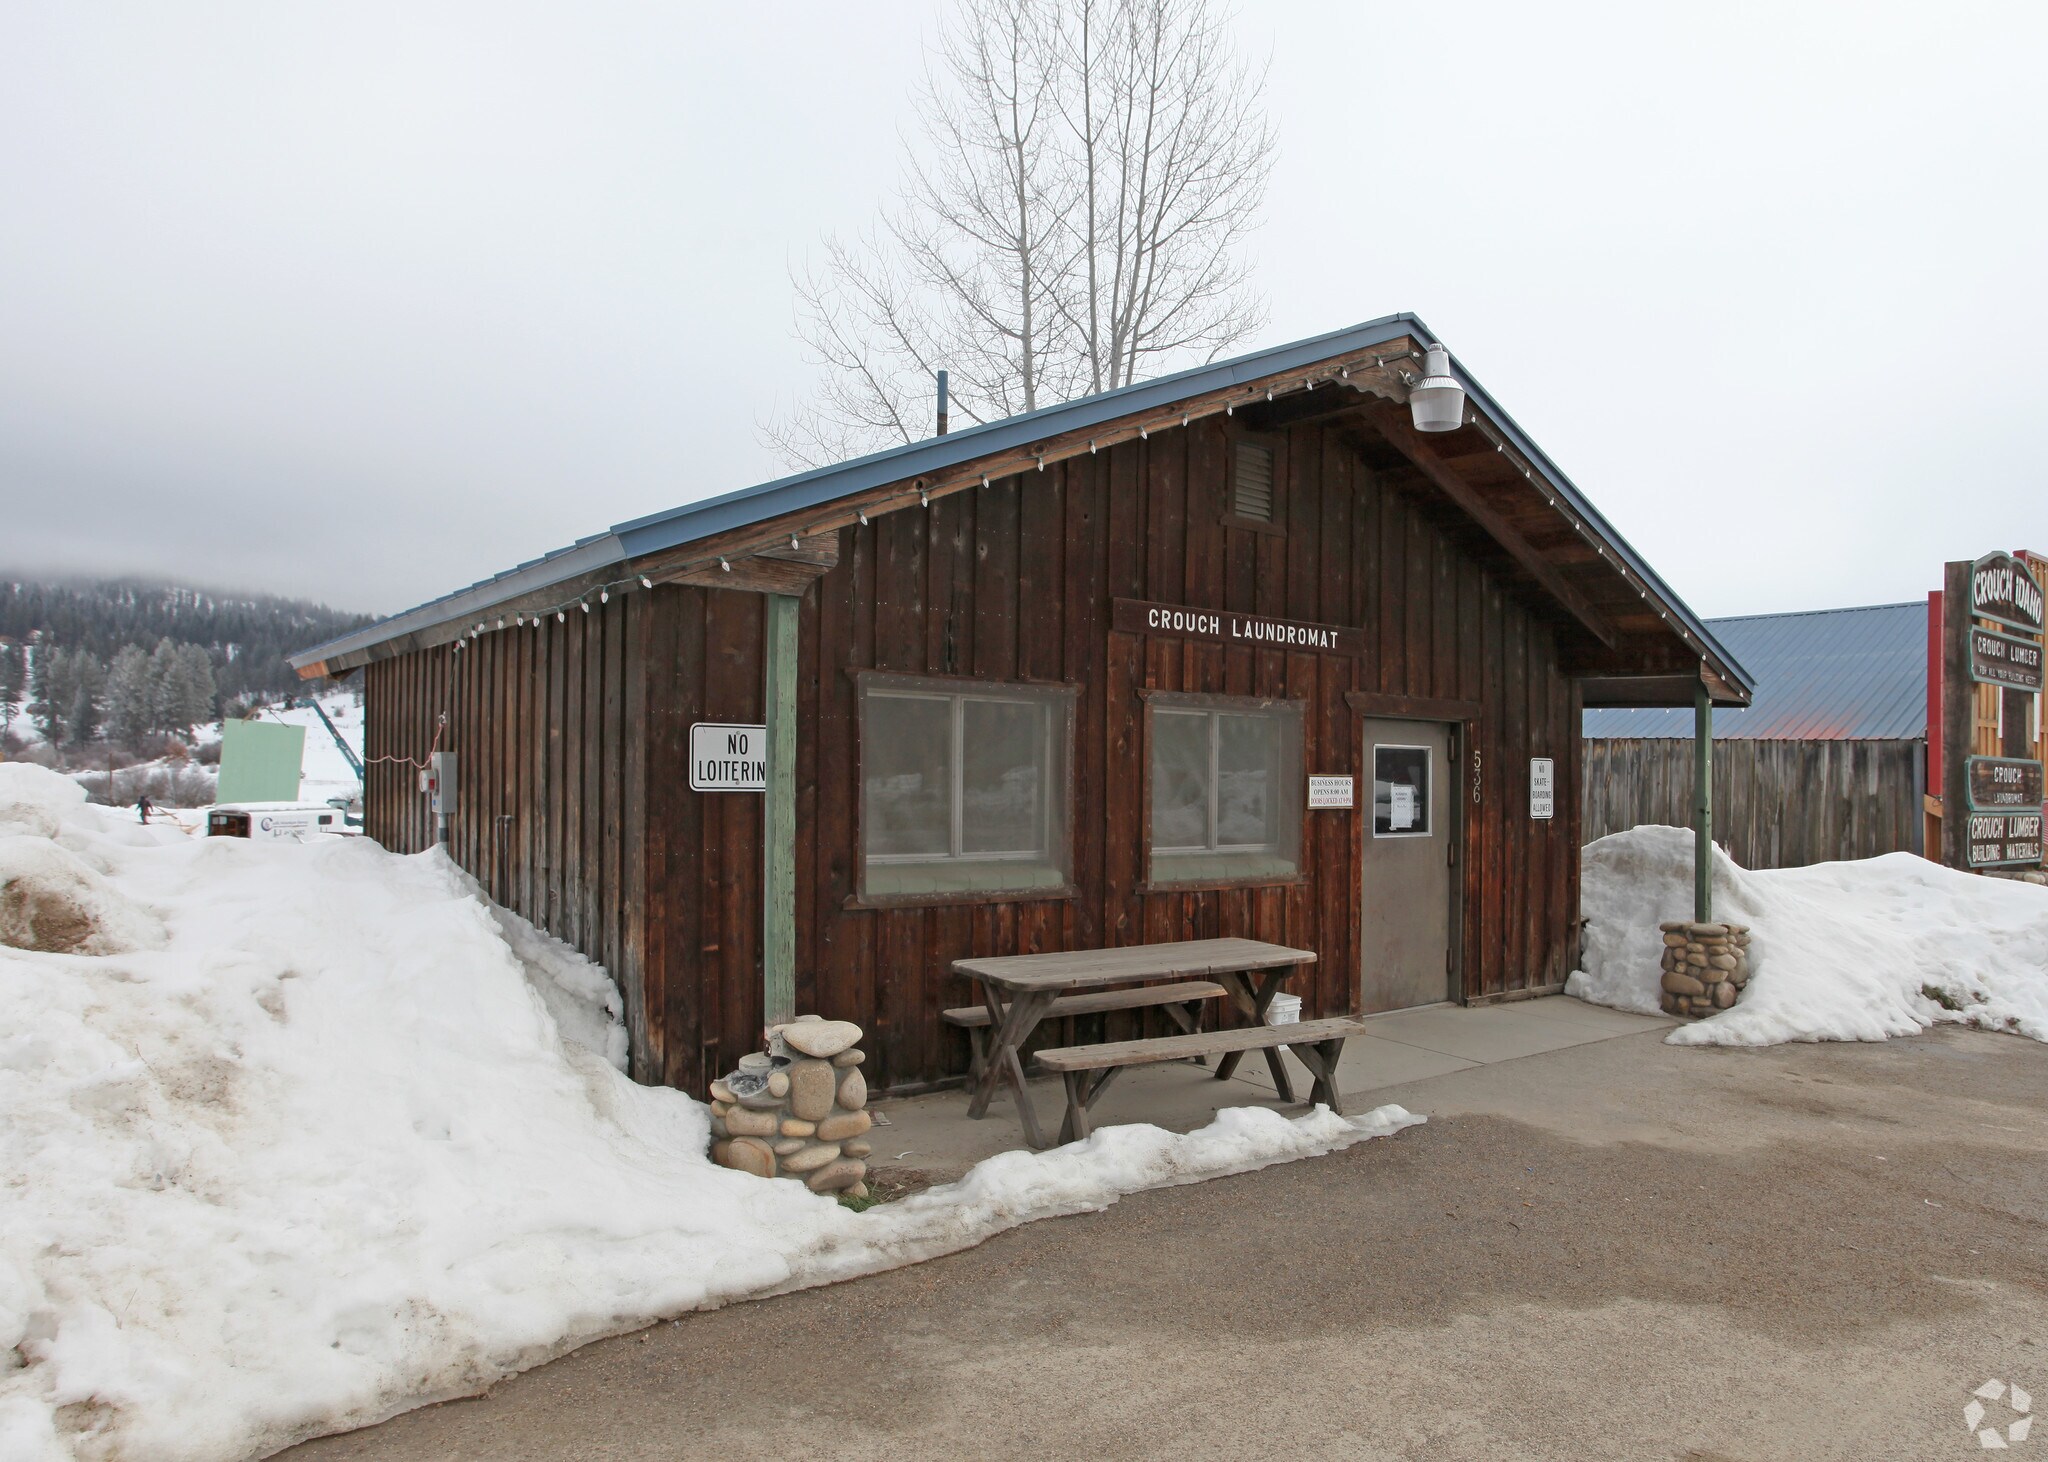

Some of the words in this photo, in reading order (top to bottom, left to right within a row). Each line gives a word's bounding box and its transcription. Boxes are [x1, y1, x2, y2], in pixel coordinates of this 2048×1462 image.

[1974, 568, 2012, 606] CROUCH
[1149, 609, 1219, 635] CROUCH
[1232, 618, 1338, 649] LAUNDROMAT
[1977, 636, 2006, 658] CROUCH
[2010, 644, 2038, 666] LUMBER
[728, 733, 749, 755] NO
[698, 759, 766, 782] LOITERIN
[1473, 750, 1482, 803] 536
[1538, 764, 1545, 773] NO
[1994, 766, 2022, 783] CROUCH
[1532, 790, 1551, 799] BOARDING
[1994, 793, 2023, 804] LAUNDROMAT
[1533, 803, 1551, 812] ALLOWED
[1971, 817, 2004, 839] CROUCH
[2009, 817, 2039, 838] LUMBER
[1972, 844, 2000, 862] BUILDING
[2006, 843, 2039, 860] MATERIALS
